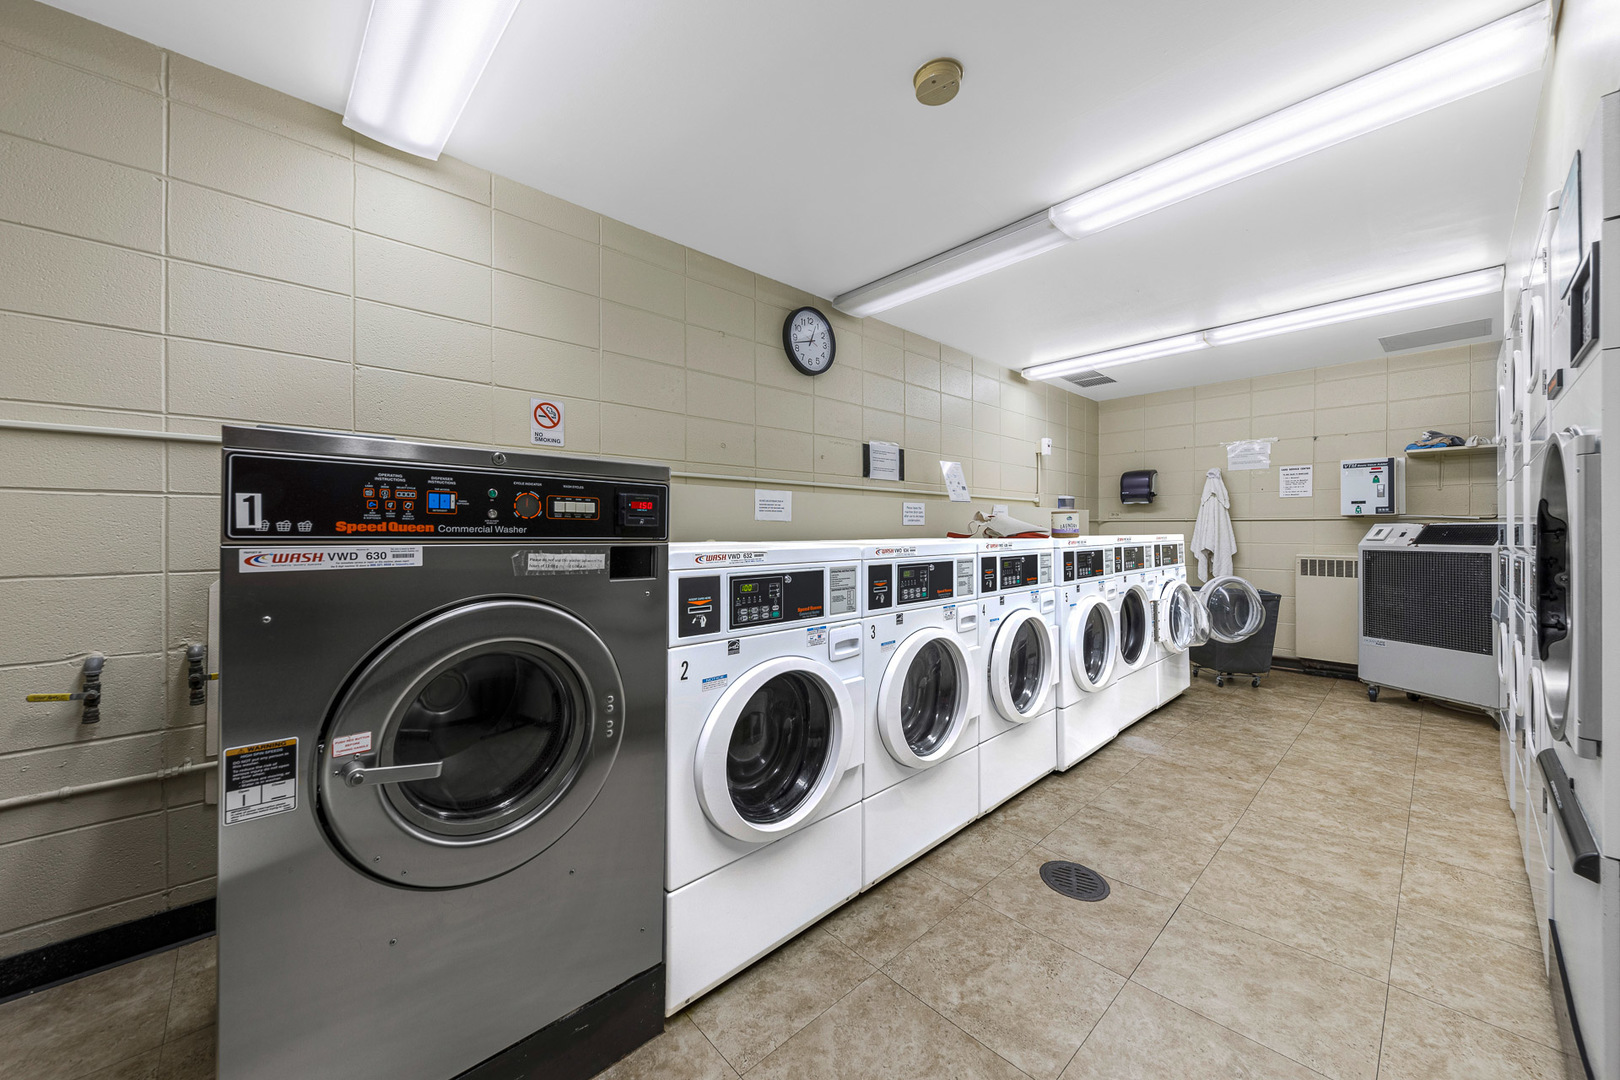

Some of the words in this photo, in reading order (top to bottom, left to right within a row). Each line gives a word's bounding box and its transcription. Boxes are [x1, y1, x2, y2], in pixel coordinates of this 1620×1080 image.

[807, 317, 813, 325] 12
[795, 324, 802, 332] 10
[243, 495, 255, 526] 1
[335, 521, 386, 534] Speed
[388, 521, 435, 532] Queen
[438, 524, 493, 534] Commercial
[495, 524, 527, 534] Washer
[272, 553, 324, 563] WASH
[328, 552, 358, 561] VWD
[366, 552, 387, 560] 630
[871, 625, 875, 639] 3
[681, 661, 688, 680] 2
[247, 741, 286, 752] WARNING
